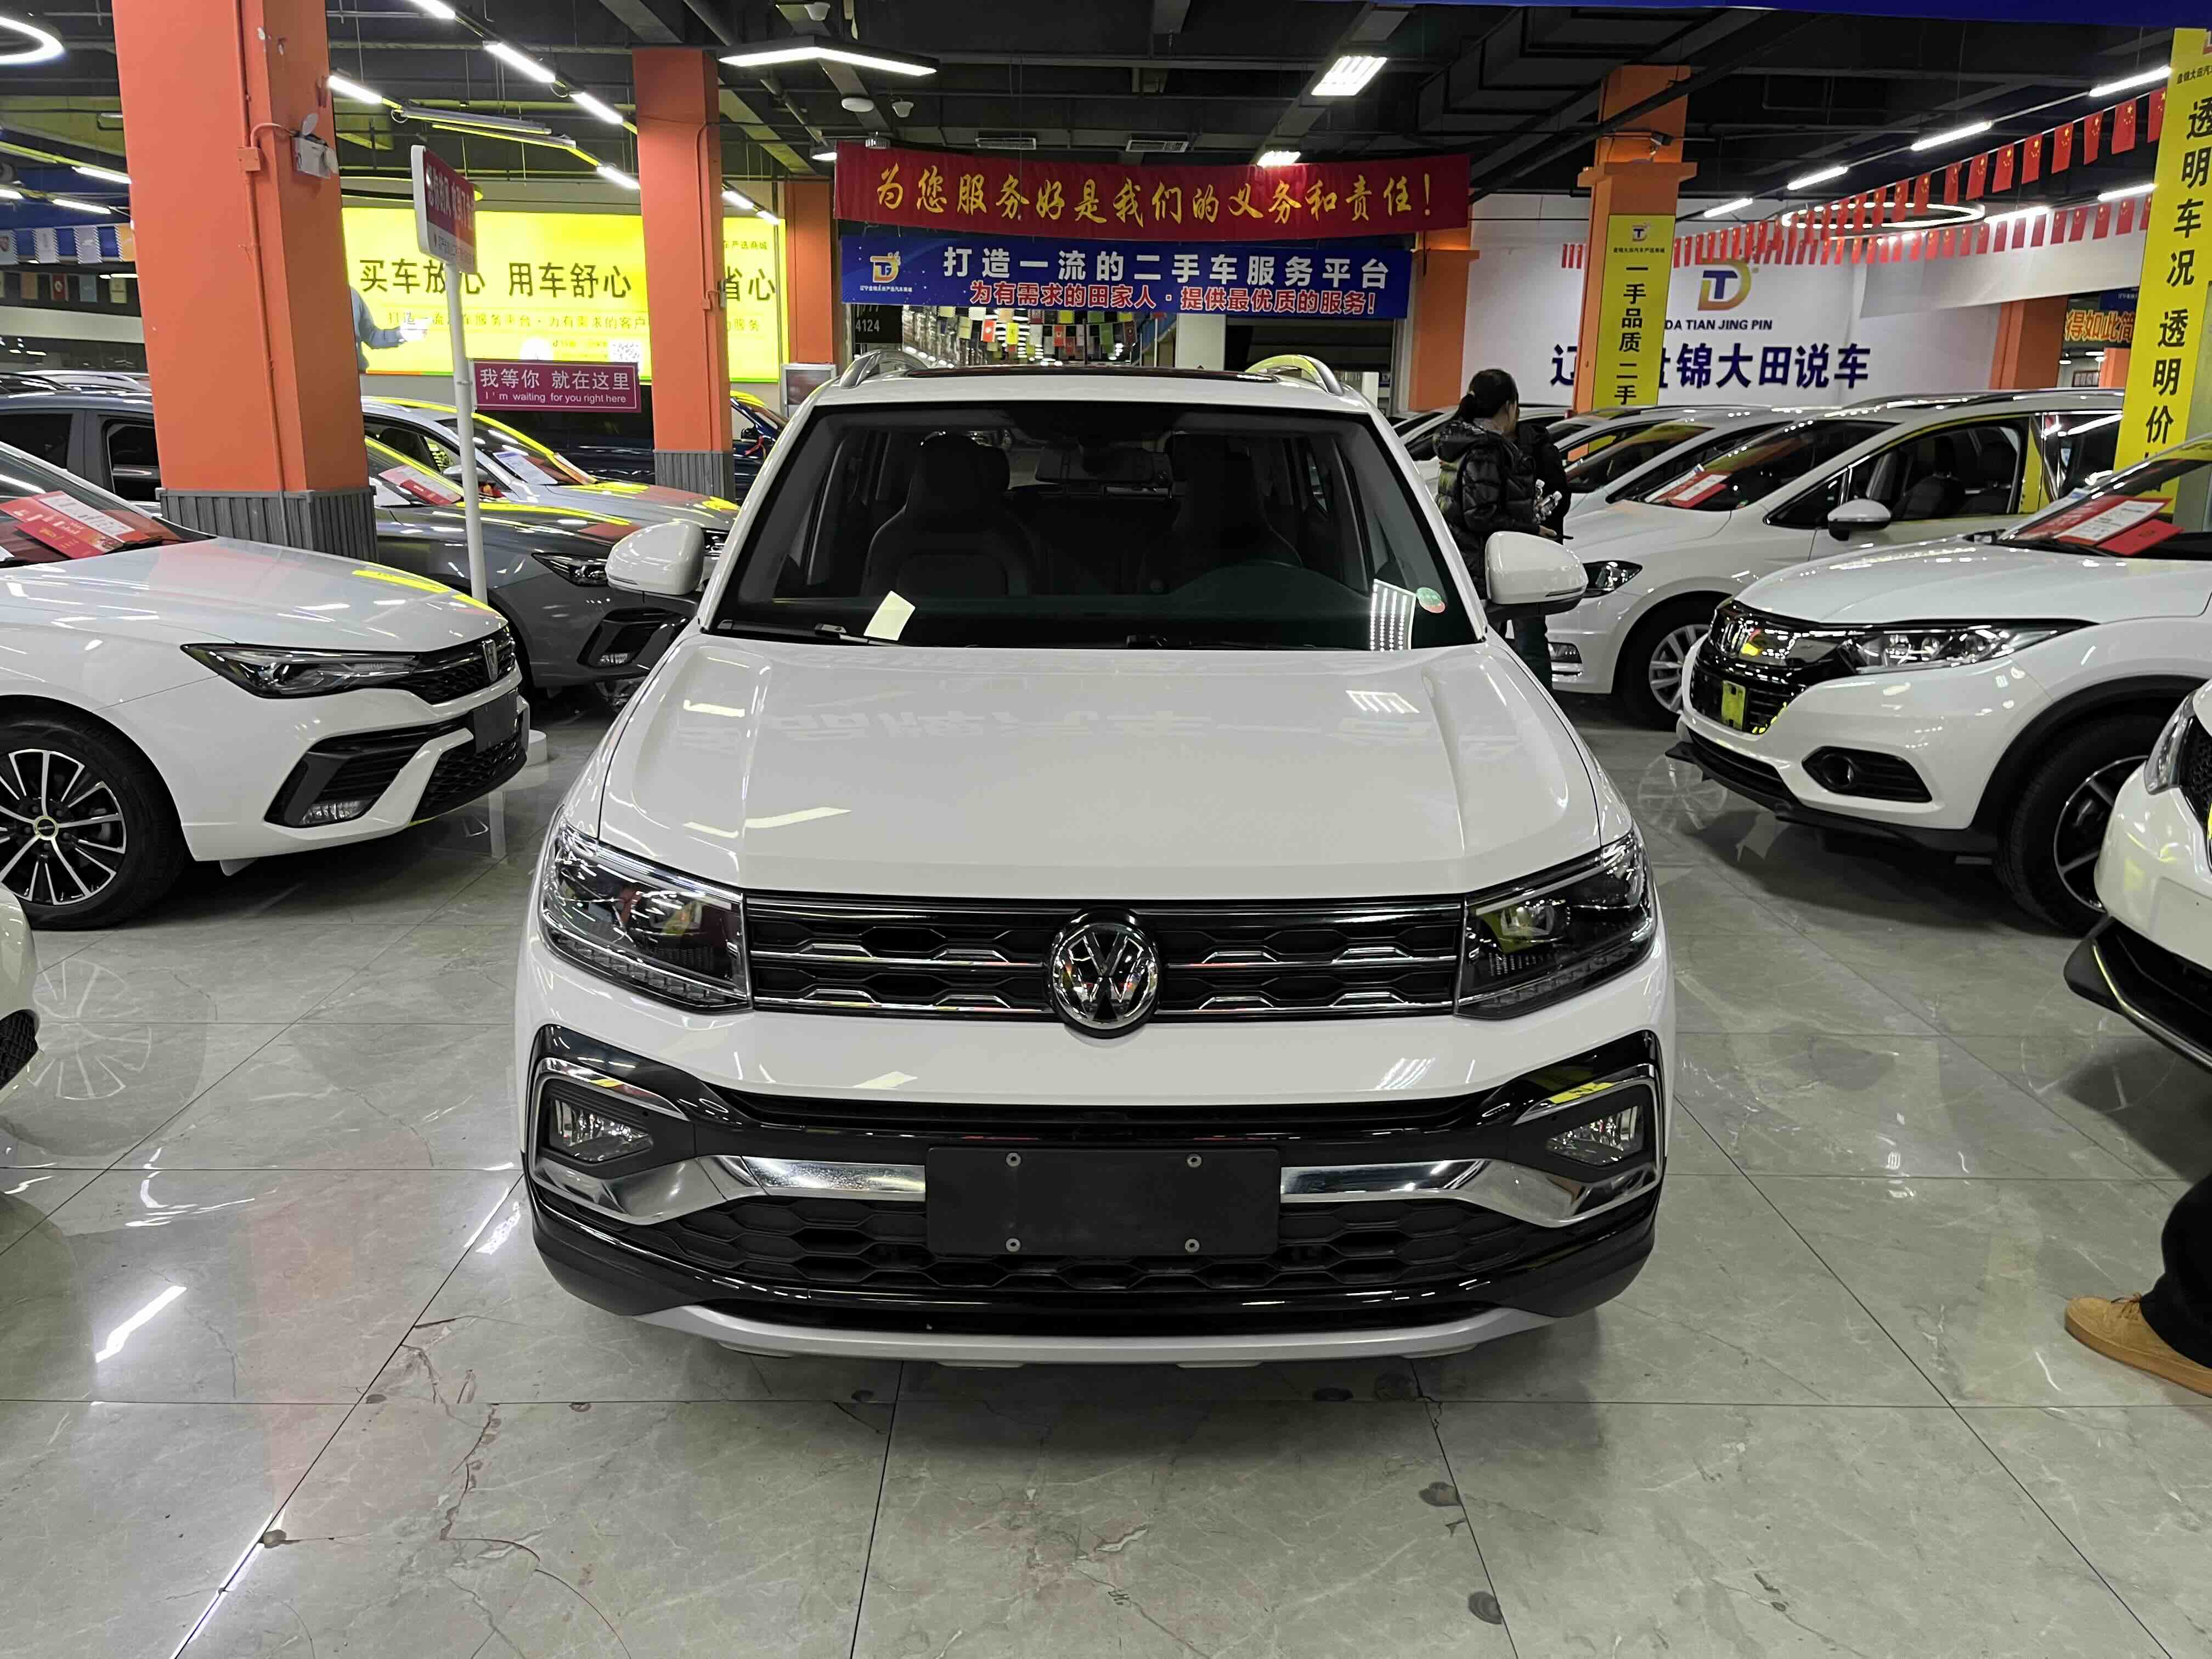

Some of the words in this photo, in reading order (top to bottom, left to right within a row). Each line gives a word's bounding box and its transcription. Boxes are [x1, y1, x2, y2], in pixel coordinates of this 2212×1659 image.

[943, 246, 1389, 289] 打造一流的二手车服务平台
[509, 262, 631, 298] 用车舒心
[855, 319, 881, 332] 4124
[1664, 319, 1682, 330] DA
[1685, 319, 1716, 330] TIAN
[1718, 319, 1748, 330] JING
[1751, 319, 1773, 330] PIN
[480, 368, 540, 389] 我等你
[551, 370, 631, 391] 就在这里
[512, 392, 546, 403] waiting
[550, 393, 563, 403] for
[564, 394, 582, 406] you
[583, 394, 605, 407] right
[605, 394, 627, 404] here
